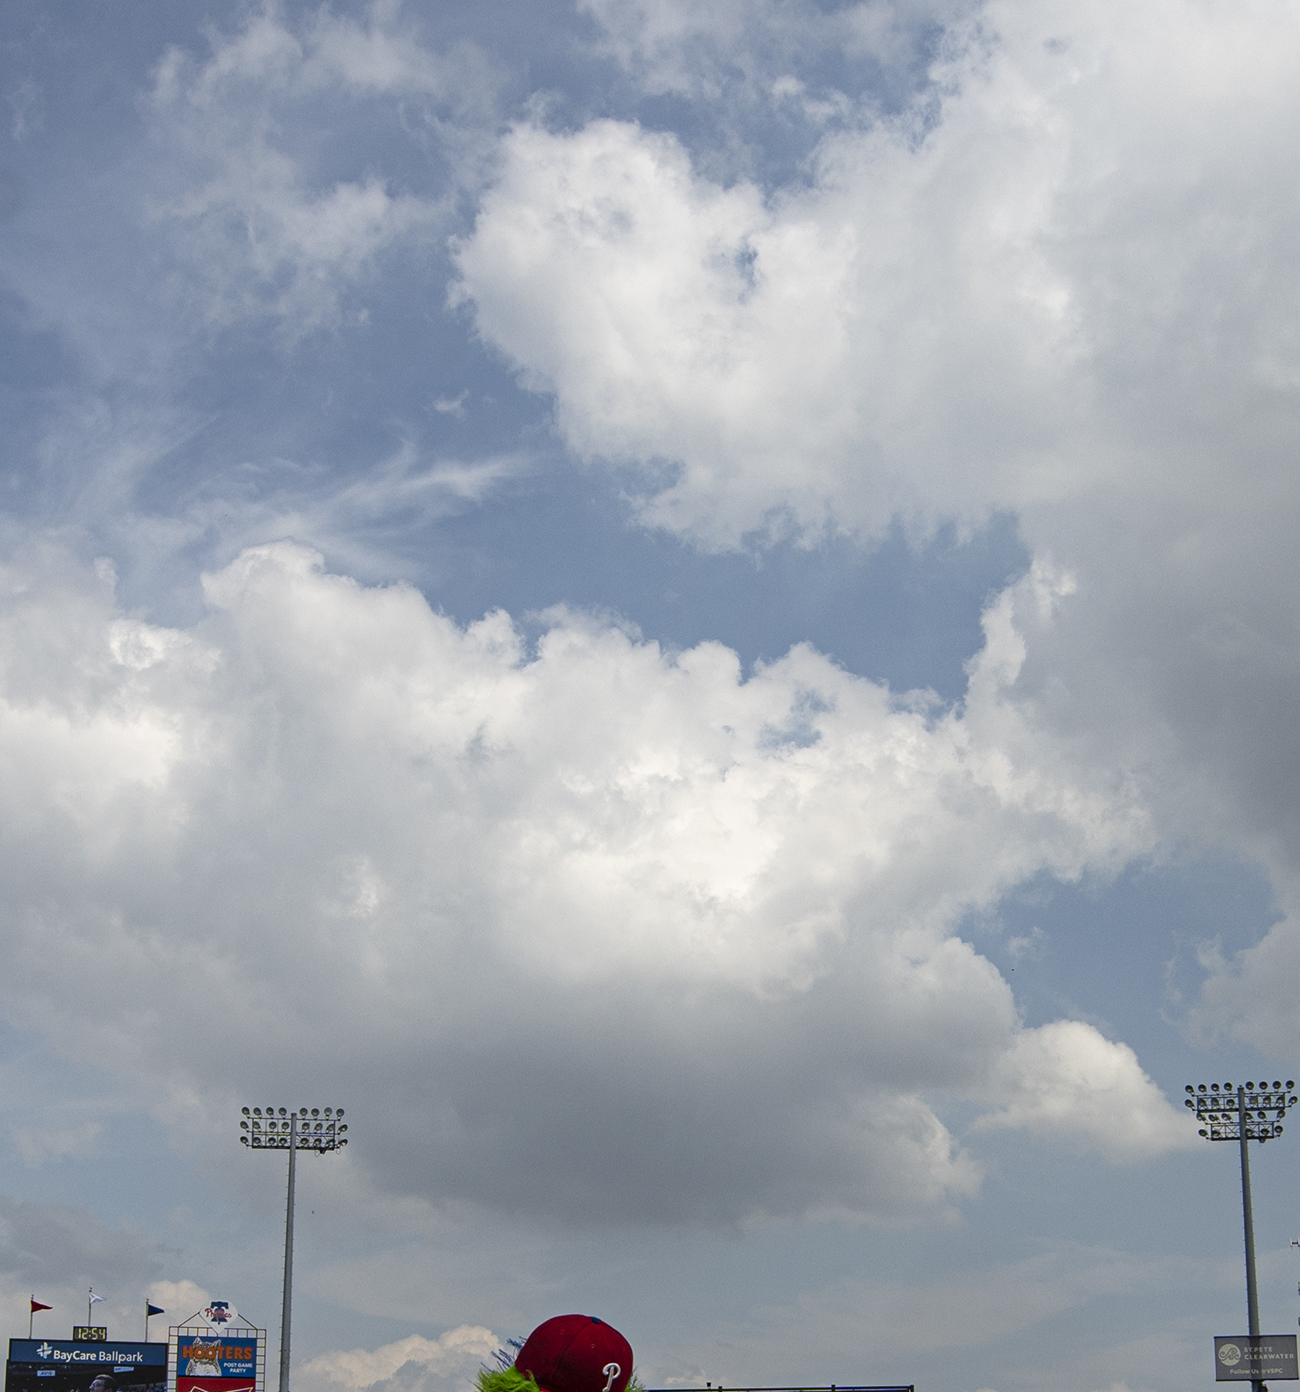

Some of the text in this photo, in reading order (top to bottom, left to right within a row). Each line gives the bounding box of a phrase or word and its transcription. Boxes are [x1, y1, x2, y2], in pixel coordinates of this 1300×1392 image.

[78, 1328, 106, 1340] 12:54
[53, 1350, 143, 1363] BayCare Ballpark
[182, 1346, 252, 1360] HOOTERS
[602, 1362, 621, 1392] P
